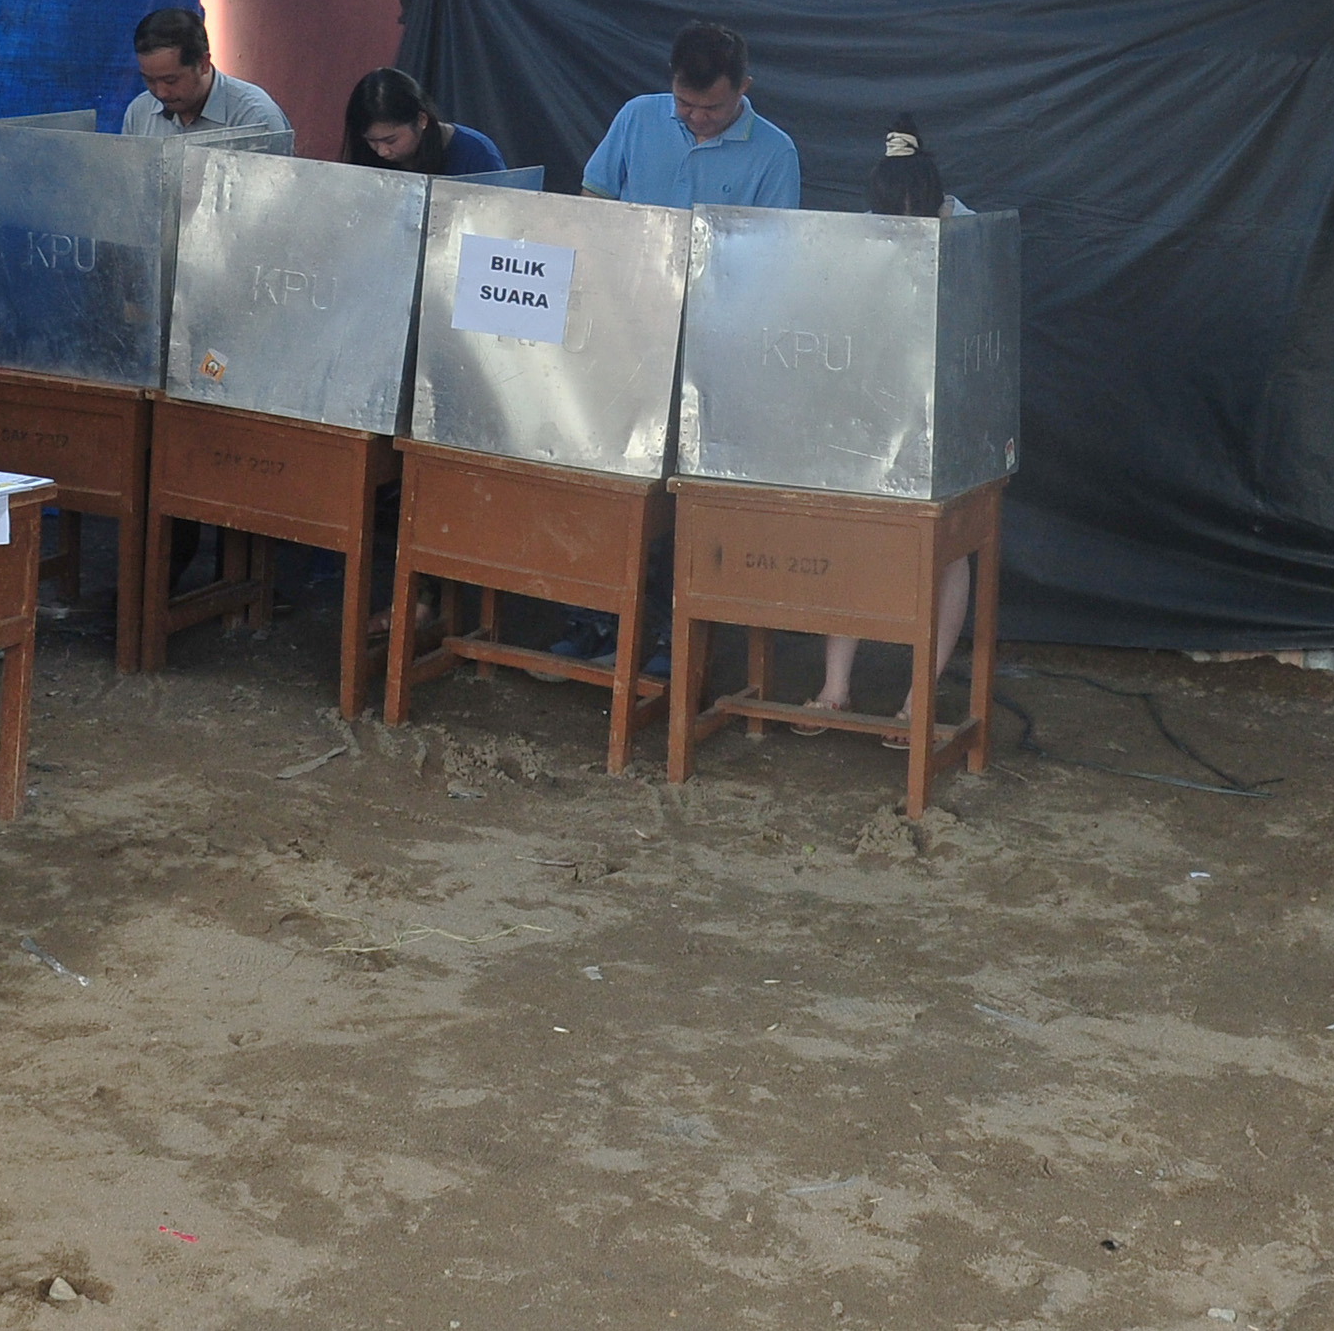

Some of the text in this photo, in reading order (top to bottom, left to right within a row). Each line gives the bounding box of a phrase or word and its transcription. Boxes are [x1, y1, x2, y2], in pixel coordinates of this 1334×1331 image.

[28, 231, 96, 272] KPU
[491, 256, 546, 277] BILIK
[253, 265, 336, 309] KPU
[480, 285, 549, 309] SUARA
[762, 327, 851, 370] KPU
